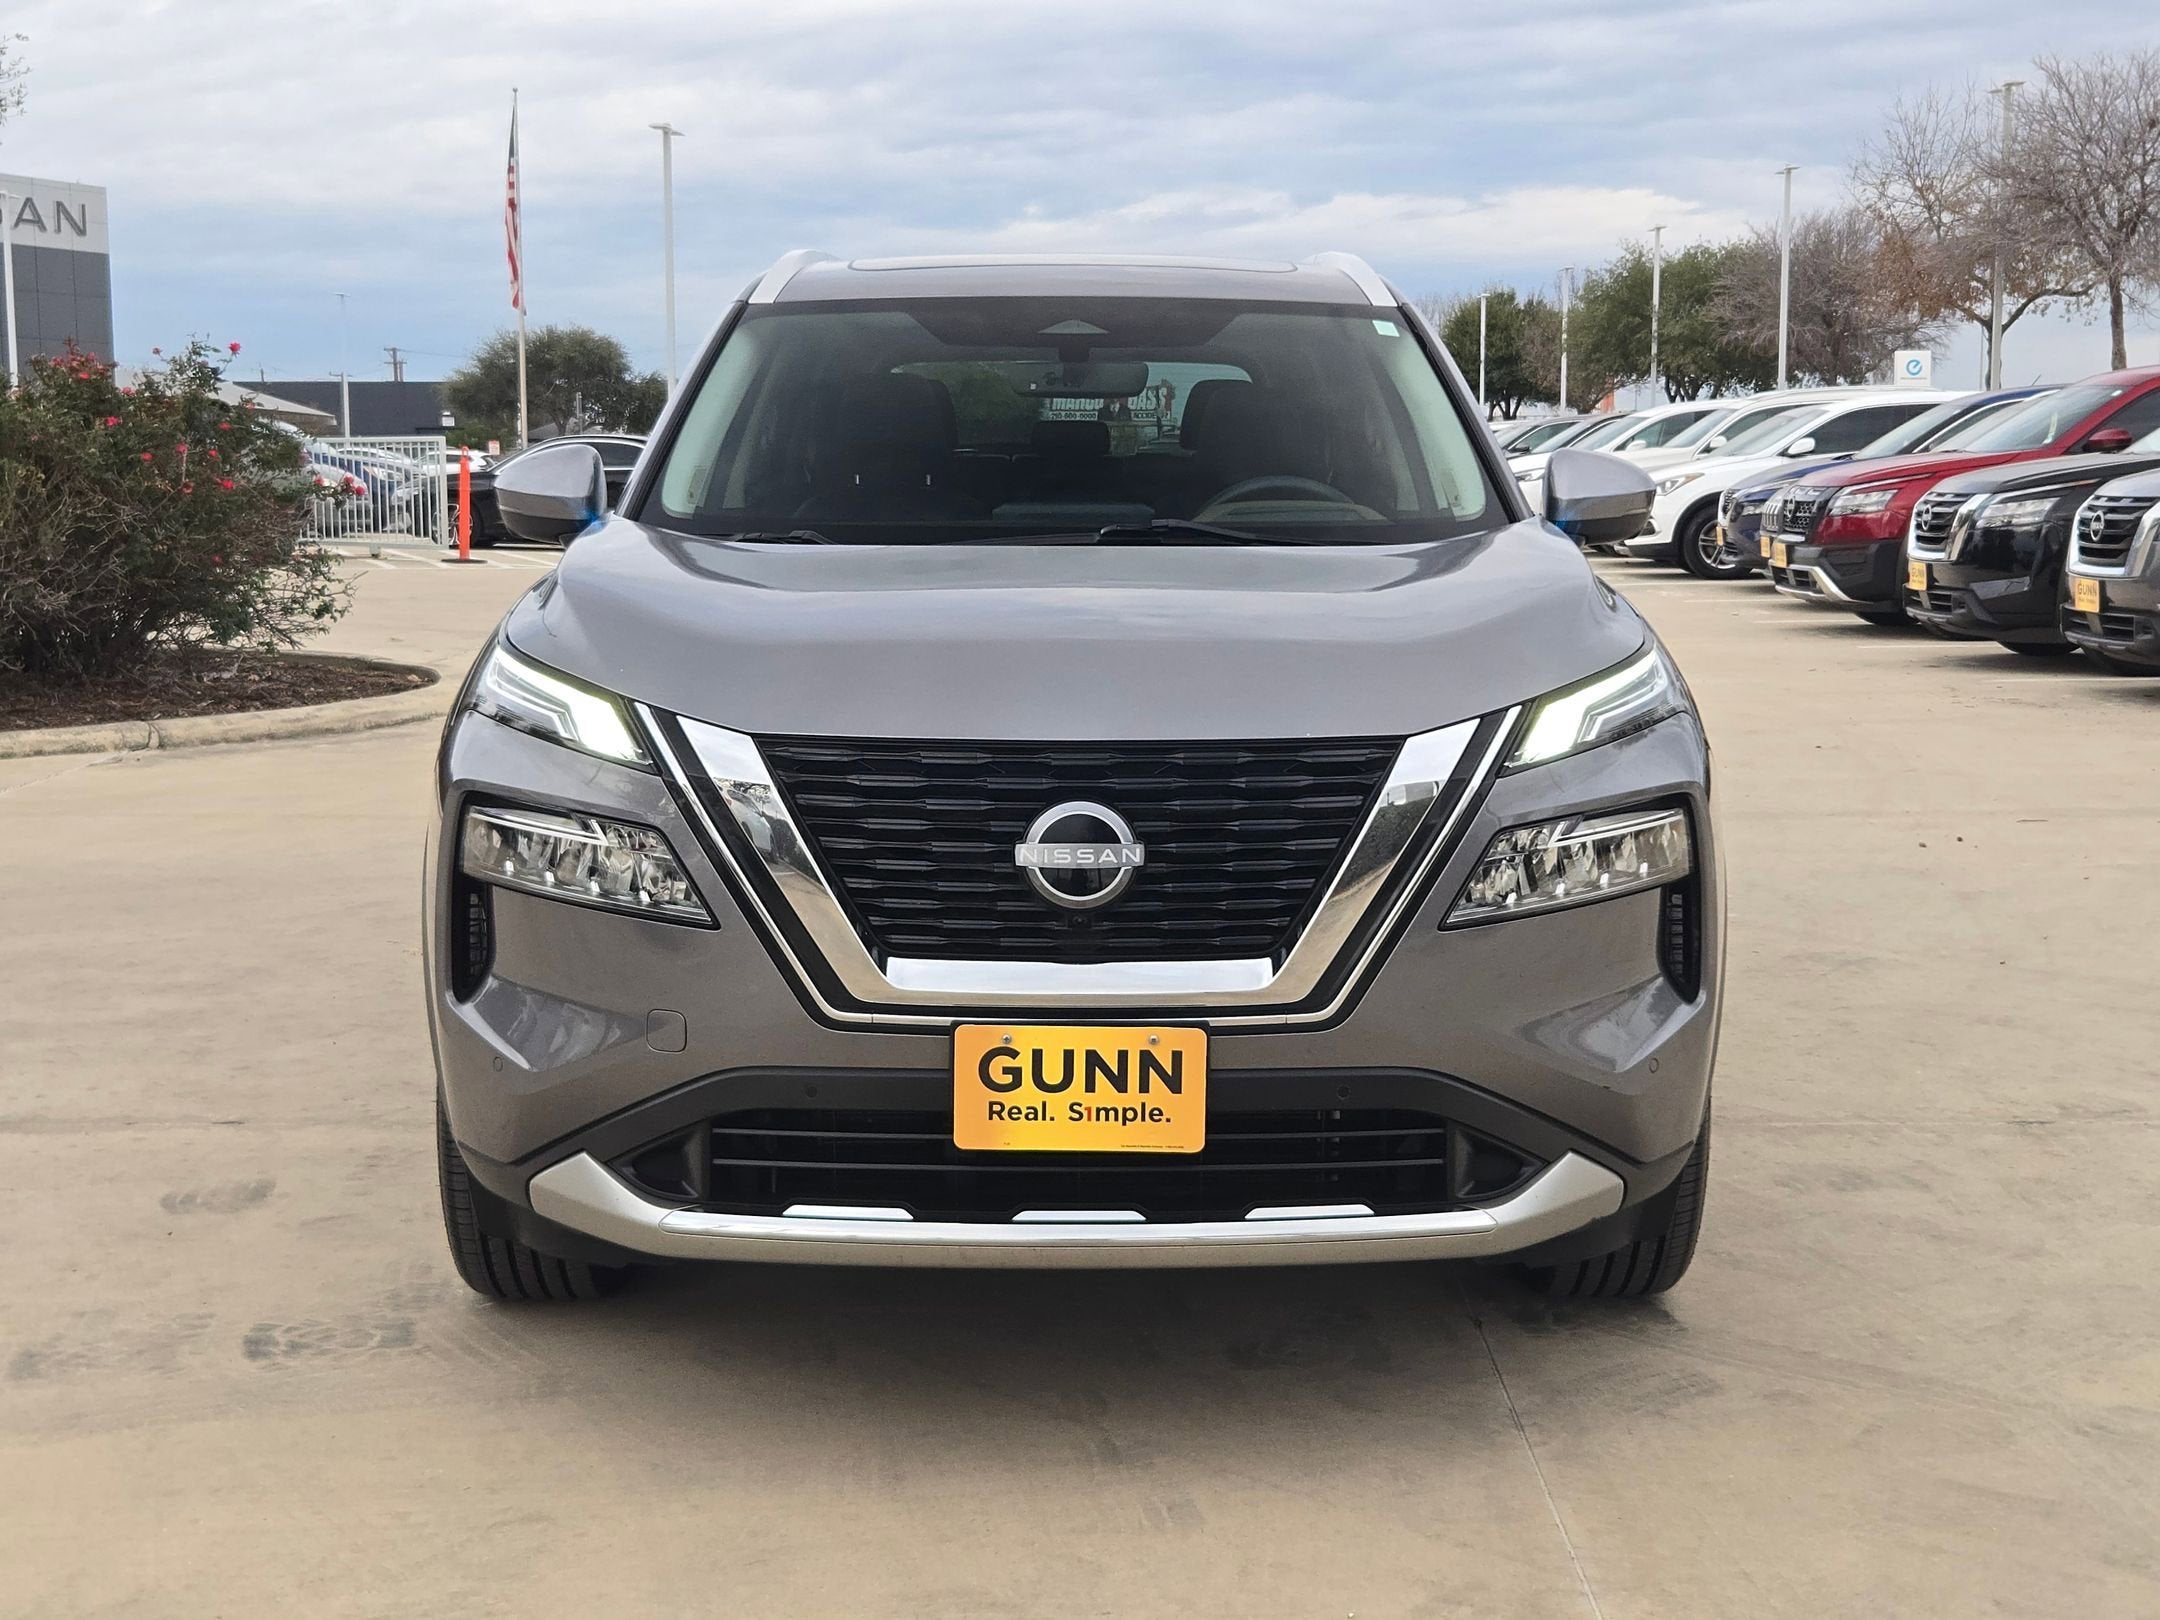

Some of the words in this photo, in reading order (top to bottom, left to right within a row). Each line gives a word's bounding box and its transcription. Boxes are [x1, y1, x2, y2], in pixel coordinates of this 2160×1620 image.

[0, 197, 87, 236] AN
[1020, 848, 1140, 863] NISSAN
[978, 1046, 1183, 1094] GUNN
[988, 1101, 1055, 1121] Real.
